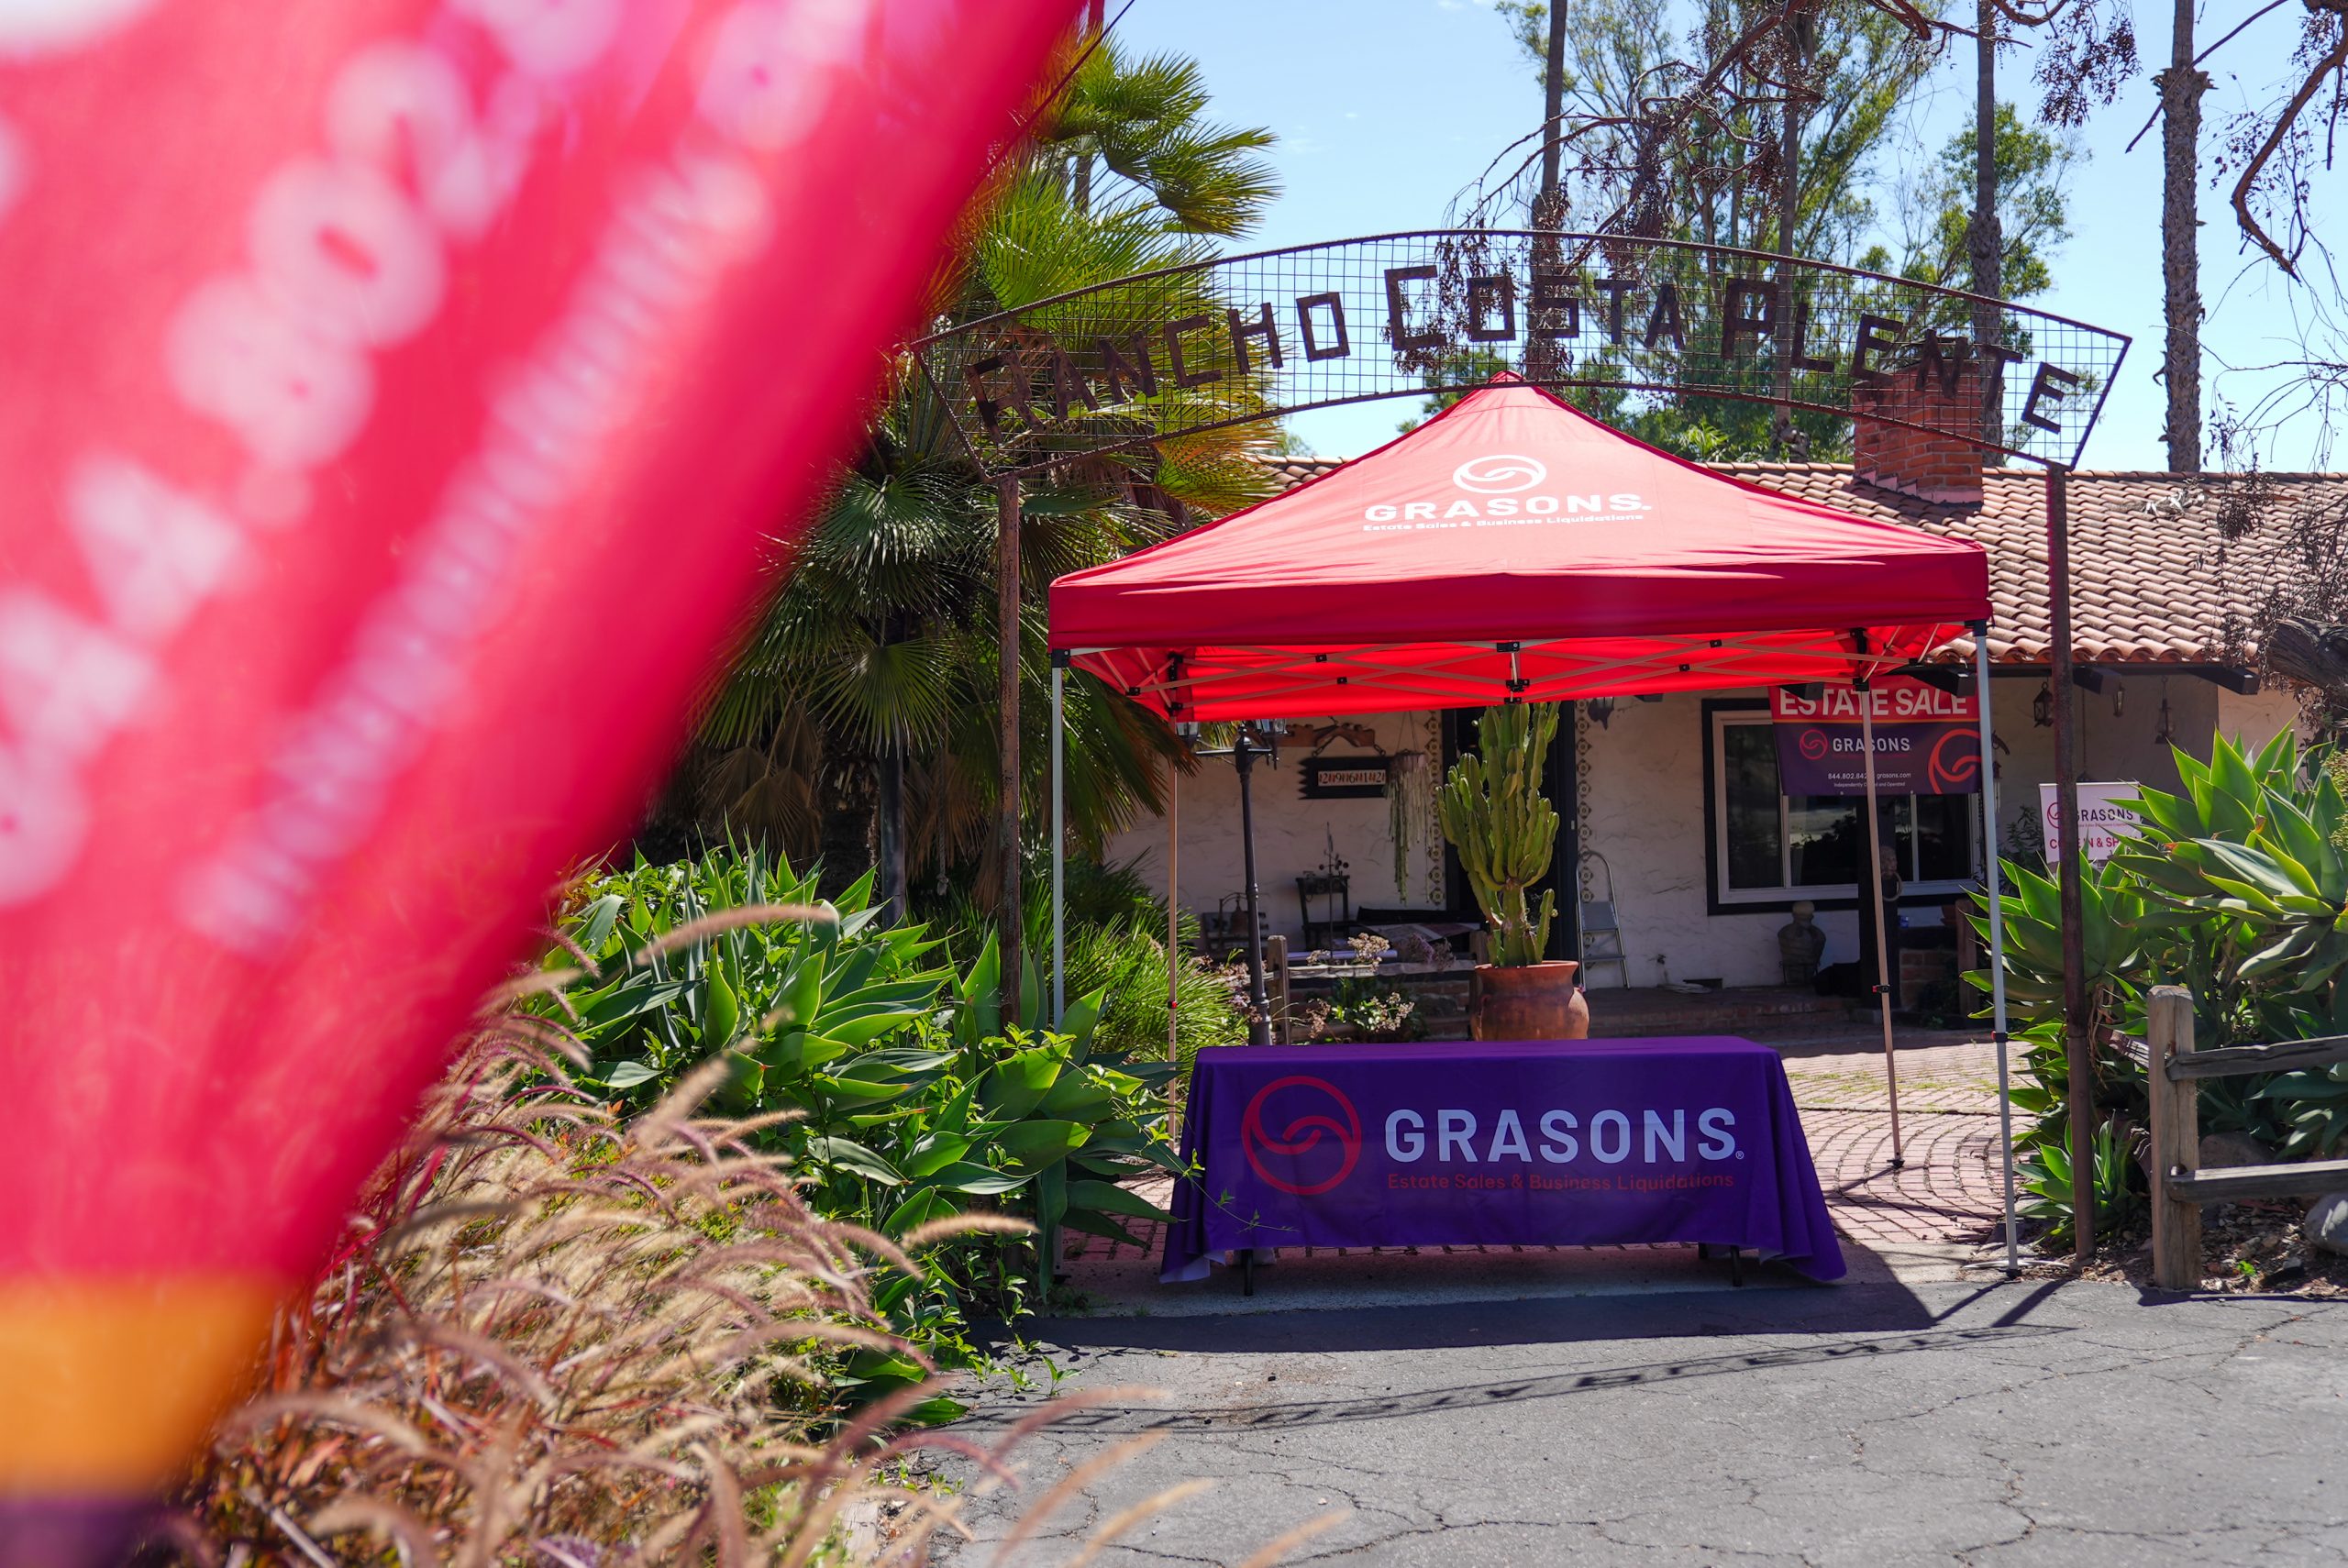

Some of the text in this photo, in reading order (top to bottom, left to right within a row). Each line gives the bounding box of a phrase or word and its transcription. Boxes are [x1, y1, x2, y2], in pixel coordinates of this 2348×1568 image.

[966, 265, 2079, 444] RANCHO COSTA PLENTE
[1363, 524, 1412, 532] Estate
[1477, 517, 1543, 526] Business
[1546, 514, 1644, 525] Liquidations
[1780, 688, 1967, 715] ESTATE SALE
[2077, 809, 2133, 822] RASONS
[2096, 837, 2103, 848] &
[1388, 1173, 1734, 1193] Estate Sales & Business Liquidations
